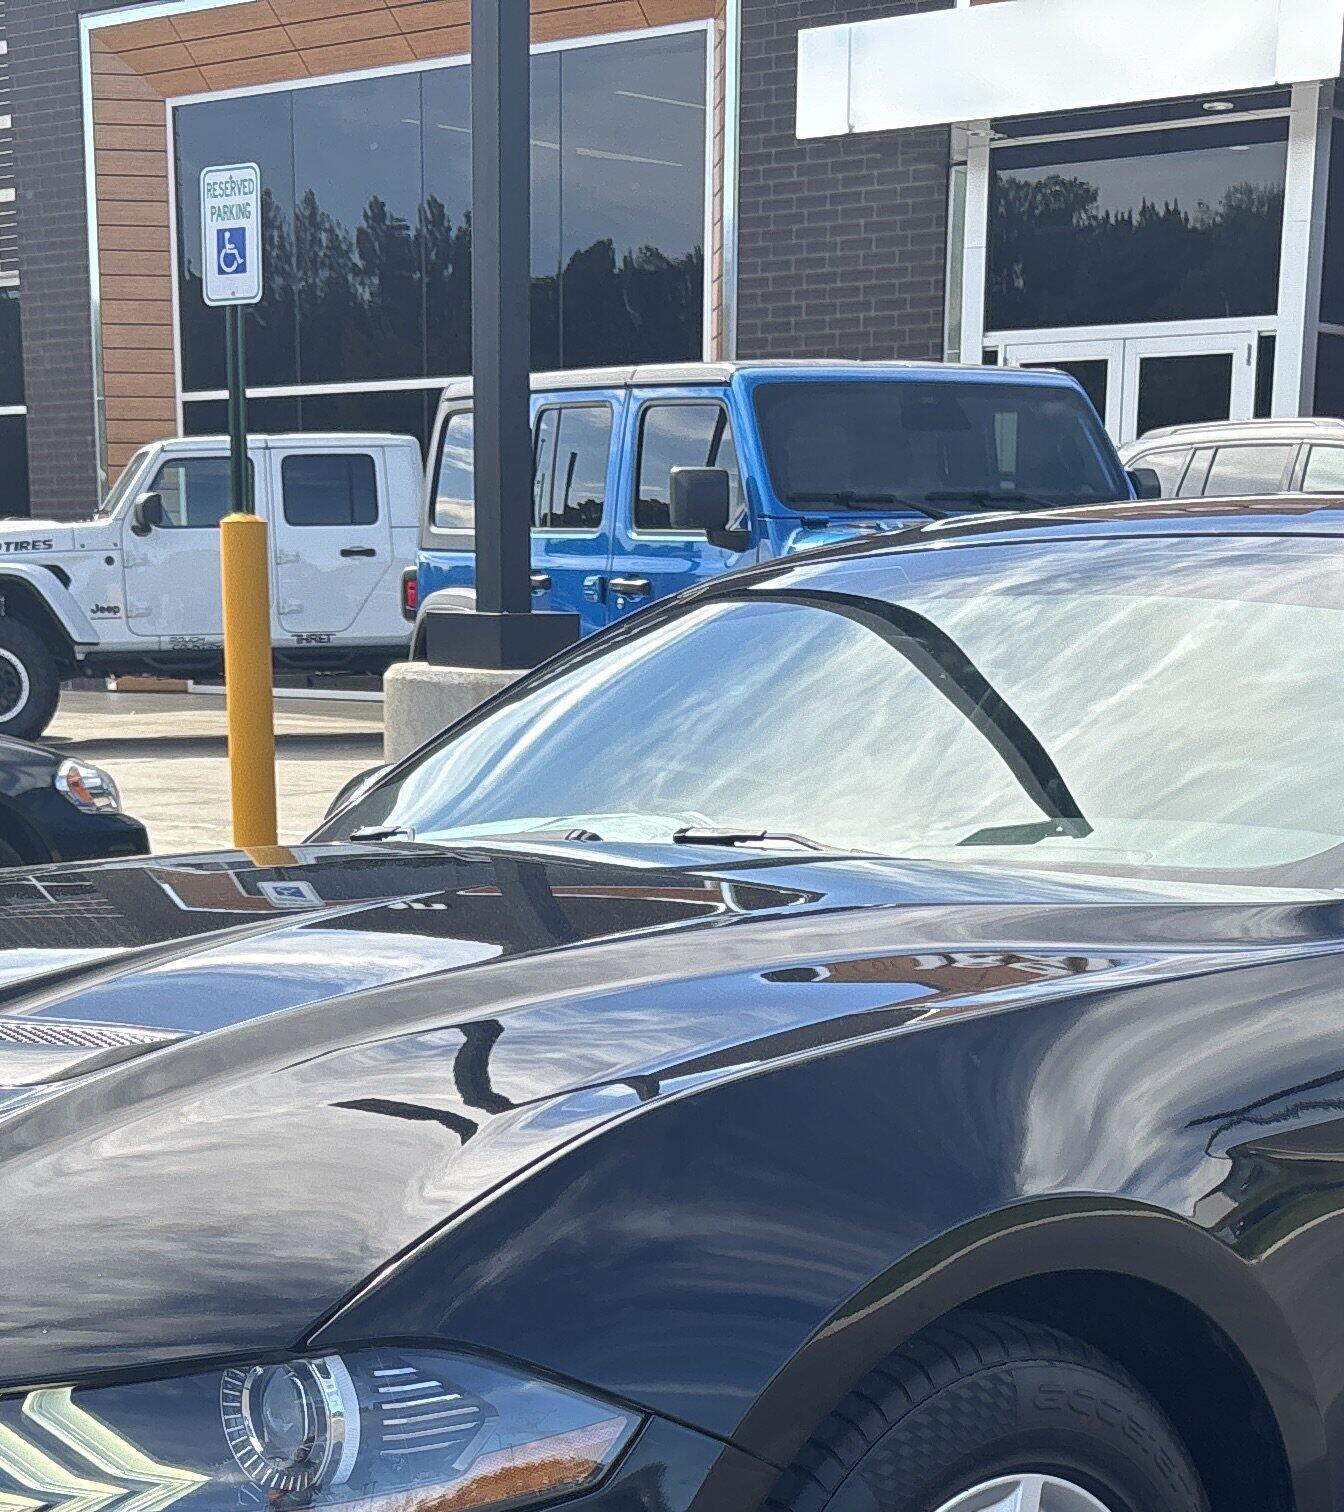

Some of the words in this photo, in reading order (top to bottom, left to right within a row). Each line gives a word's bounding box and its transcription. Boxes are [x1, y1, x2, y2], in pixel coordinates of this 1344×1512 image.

[207, 178, 255, 199] RESERVED
[210, 202, 252, 222] PARKING
[4, 539, 54, 552] TIRES
[90, 603, 121, 615] Jeep
